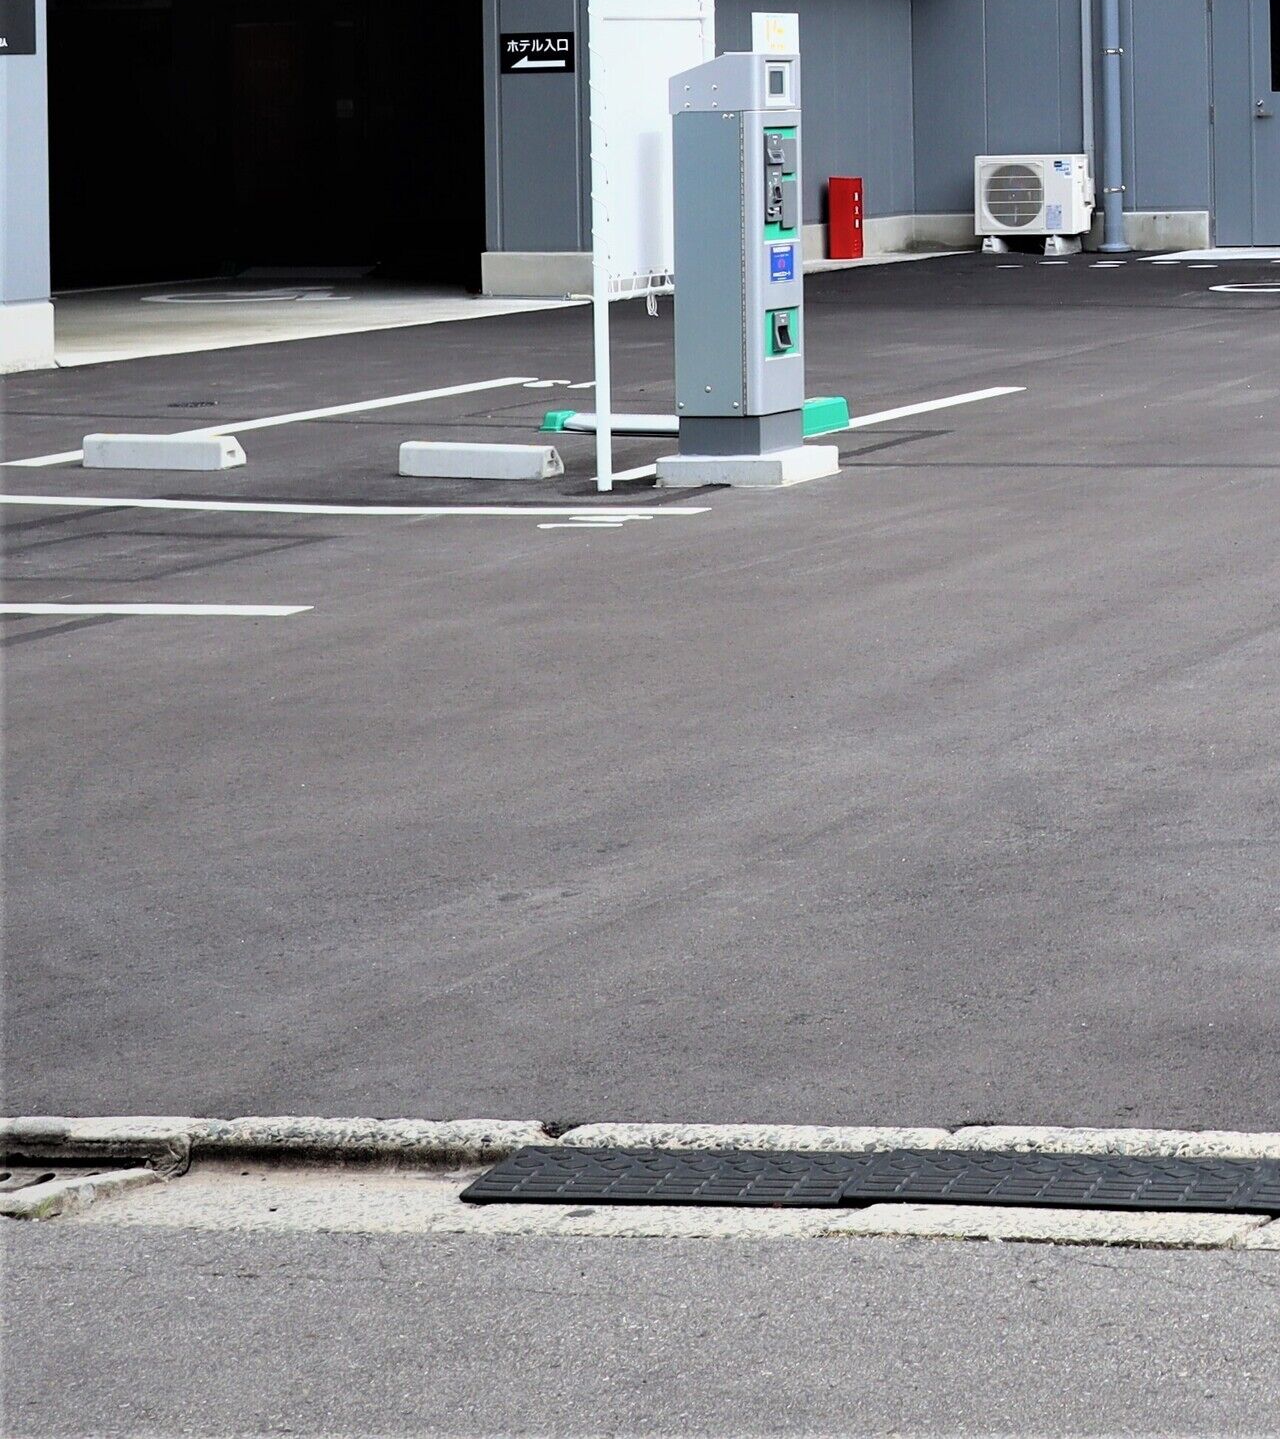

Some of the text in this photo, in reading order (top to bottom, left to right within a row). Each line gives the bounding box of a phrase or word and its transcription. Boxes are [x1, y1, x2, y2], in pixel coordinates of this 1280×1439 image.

[507, 38, 569, 53] ホテル入口
